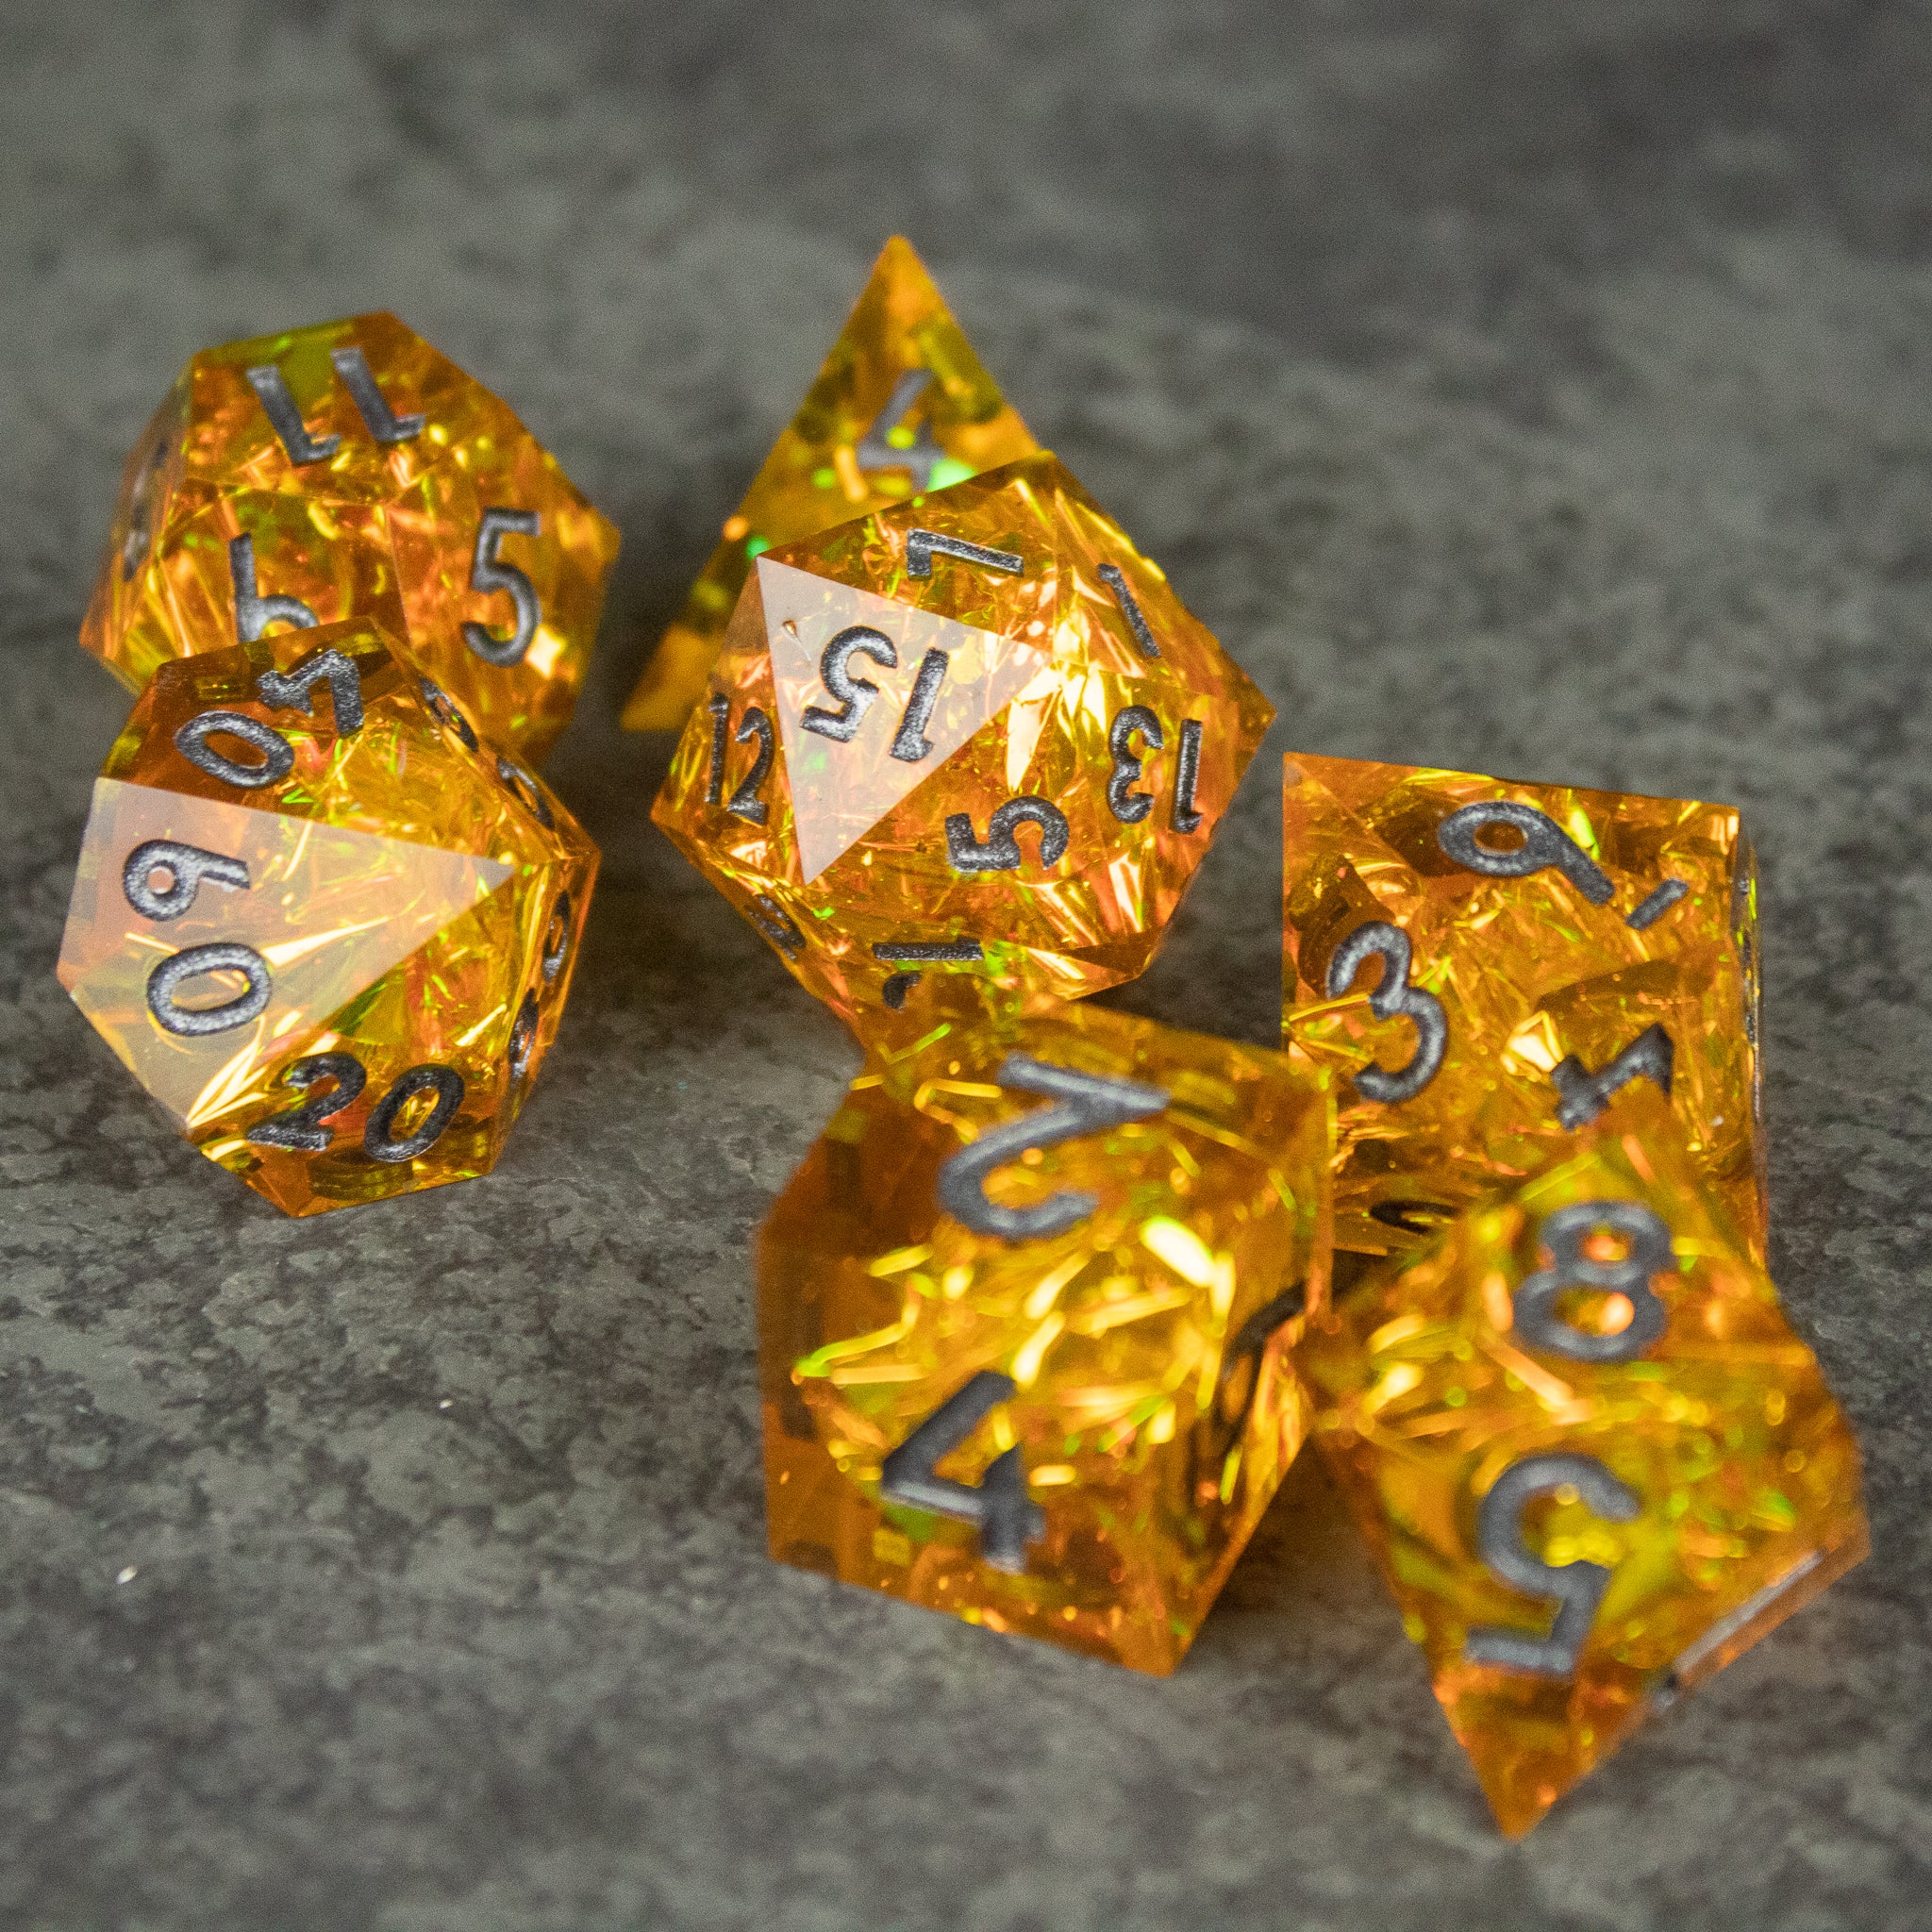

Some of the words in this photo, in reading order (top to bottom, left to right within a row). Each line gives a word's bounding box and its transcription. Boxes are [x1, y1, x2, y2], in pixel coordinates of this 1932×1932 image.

[460, 507, 542, 667] 5
[1098, 562, 1161, 658] 1
[174, 648, 364, 789] 40
[705, 692, 774, 825] 12
[800, 625, 950, 762] 15
[943, 795, 1071, 873] 5
[1108, 704, 1205, 834] 13
[1324, 920, 1448, 1104] 3
[246, 1050, 465, 1162] 20
[940, 1049, 1172, 1241] 2
[1513, 1200, 1676, 1362] 8
[879, 1369, 1045, 1574] 4
[1465, 1454, 1643, 1676] 5
